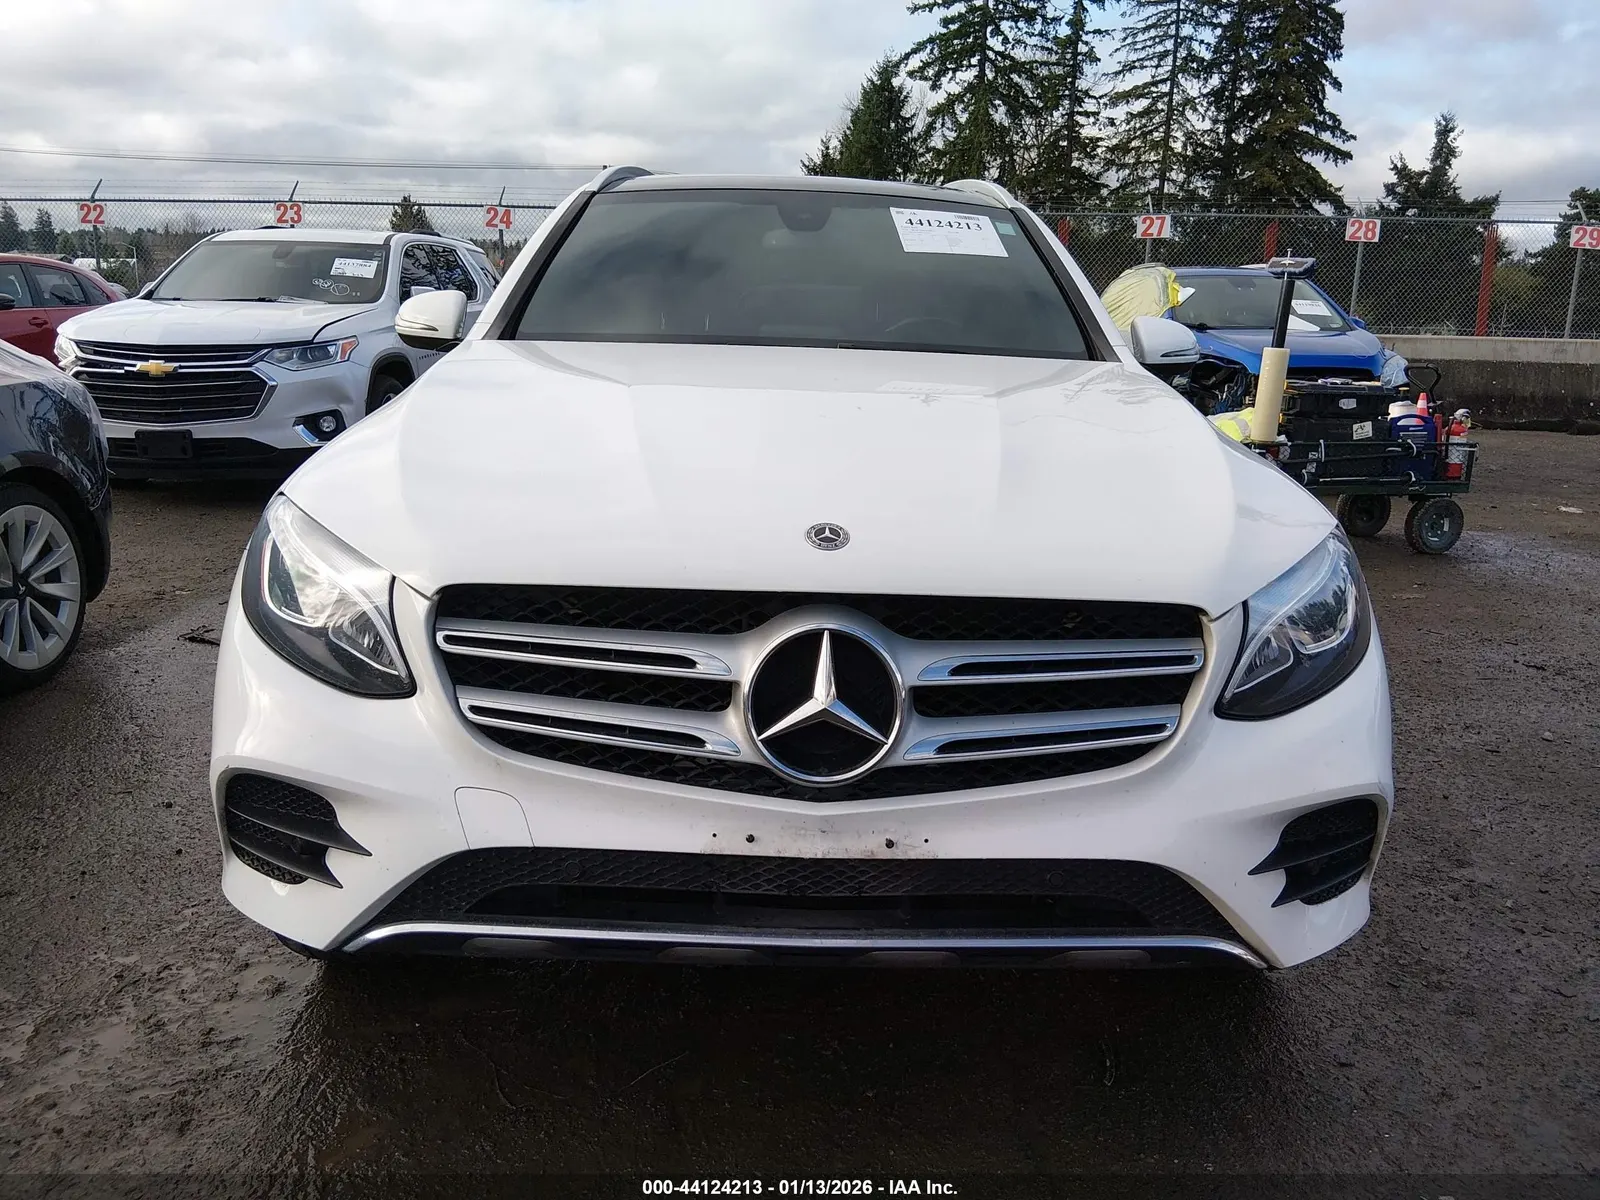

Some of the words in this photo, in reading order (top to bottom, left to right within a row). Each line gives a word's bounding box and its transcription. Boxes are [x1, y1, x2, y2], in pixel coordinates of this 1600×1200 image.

[80, 203, 105, 224] 22
[276, 203, 303, 224] 23
[485, 206, 512, 229] 24
[904, 218, 983, 232] 44124213
[1140, 216, 1166, 237] 27
[1349, 219, 1378, 242] 28
[1573, 226, 1600, 248] 29
